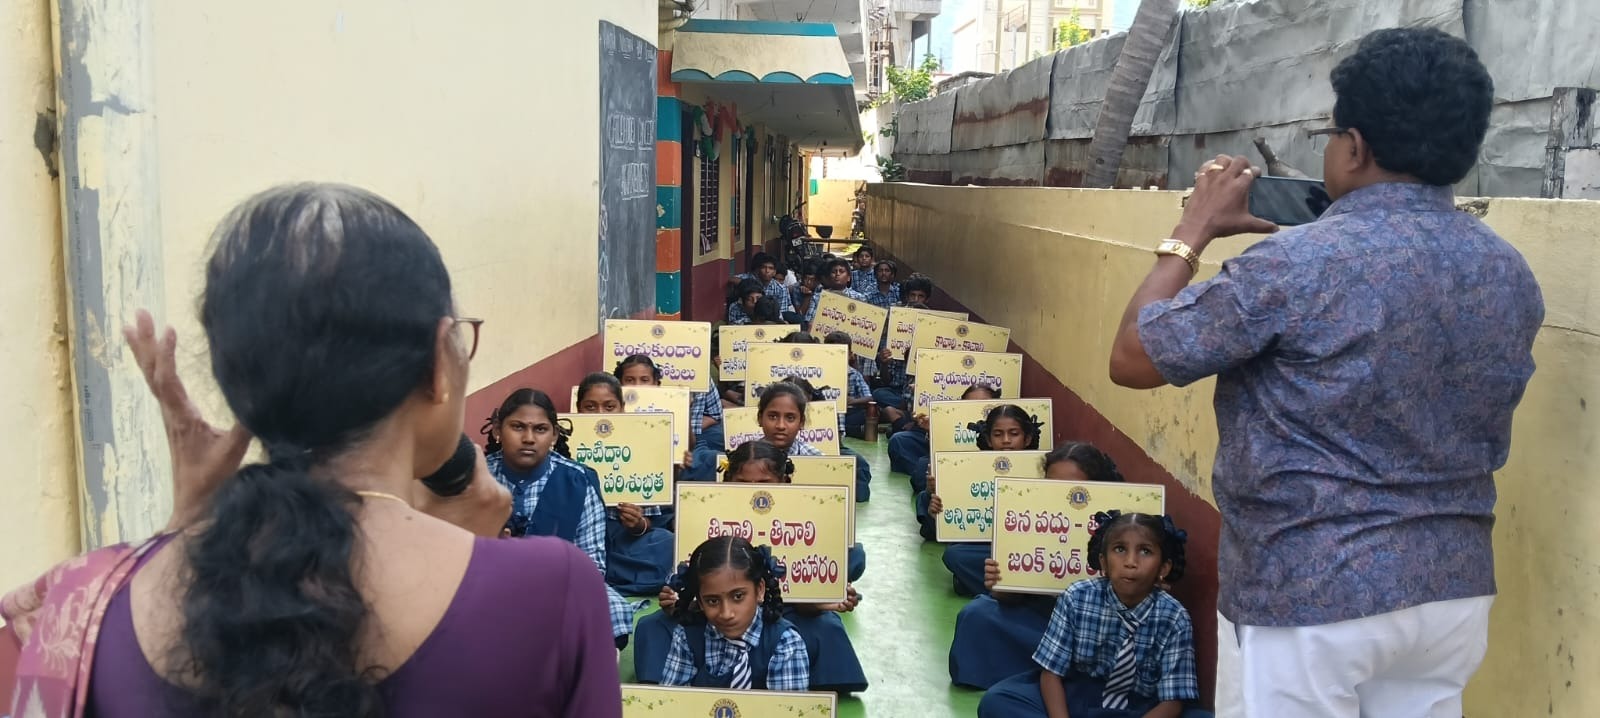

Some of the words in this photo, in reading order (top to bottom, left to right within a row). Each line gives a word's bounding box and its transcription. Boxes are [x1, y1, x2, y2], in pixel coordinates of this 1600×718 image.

[613, 342, 702, 359] పెంచుకుందాం
[798, 427, 834, 443] కుందాం
[603, 472, 664, 499] పరిశుభ్రత
[769, 519, 816, 546] తినాలి
[791, 553, 838, 584] ఆహారం
[1007, 547, 1046, 572] జంక్
